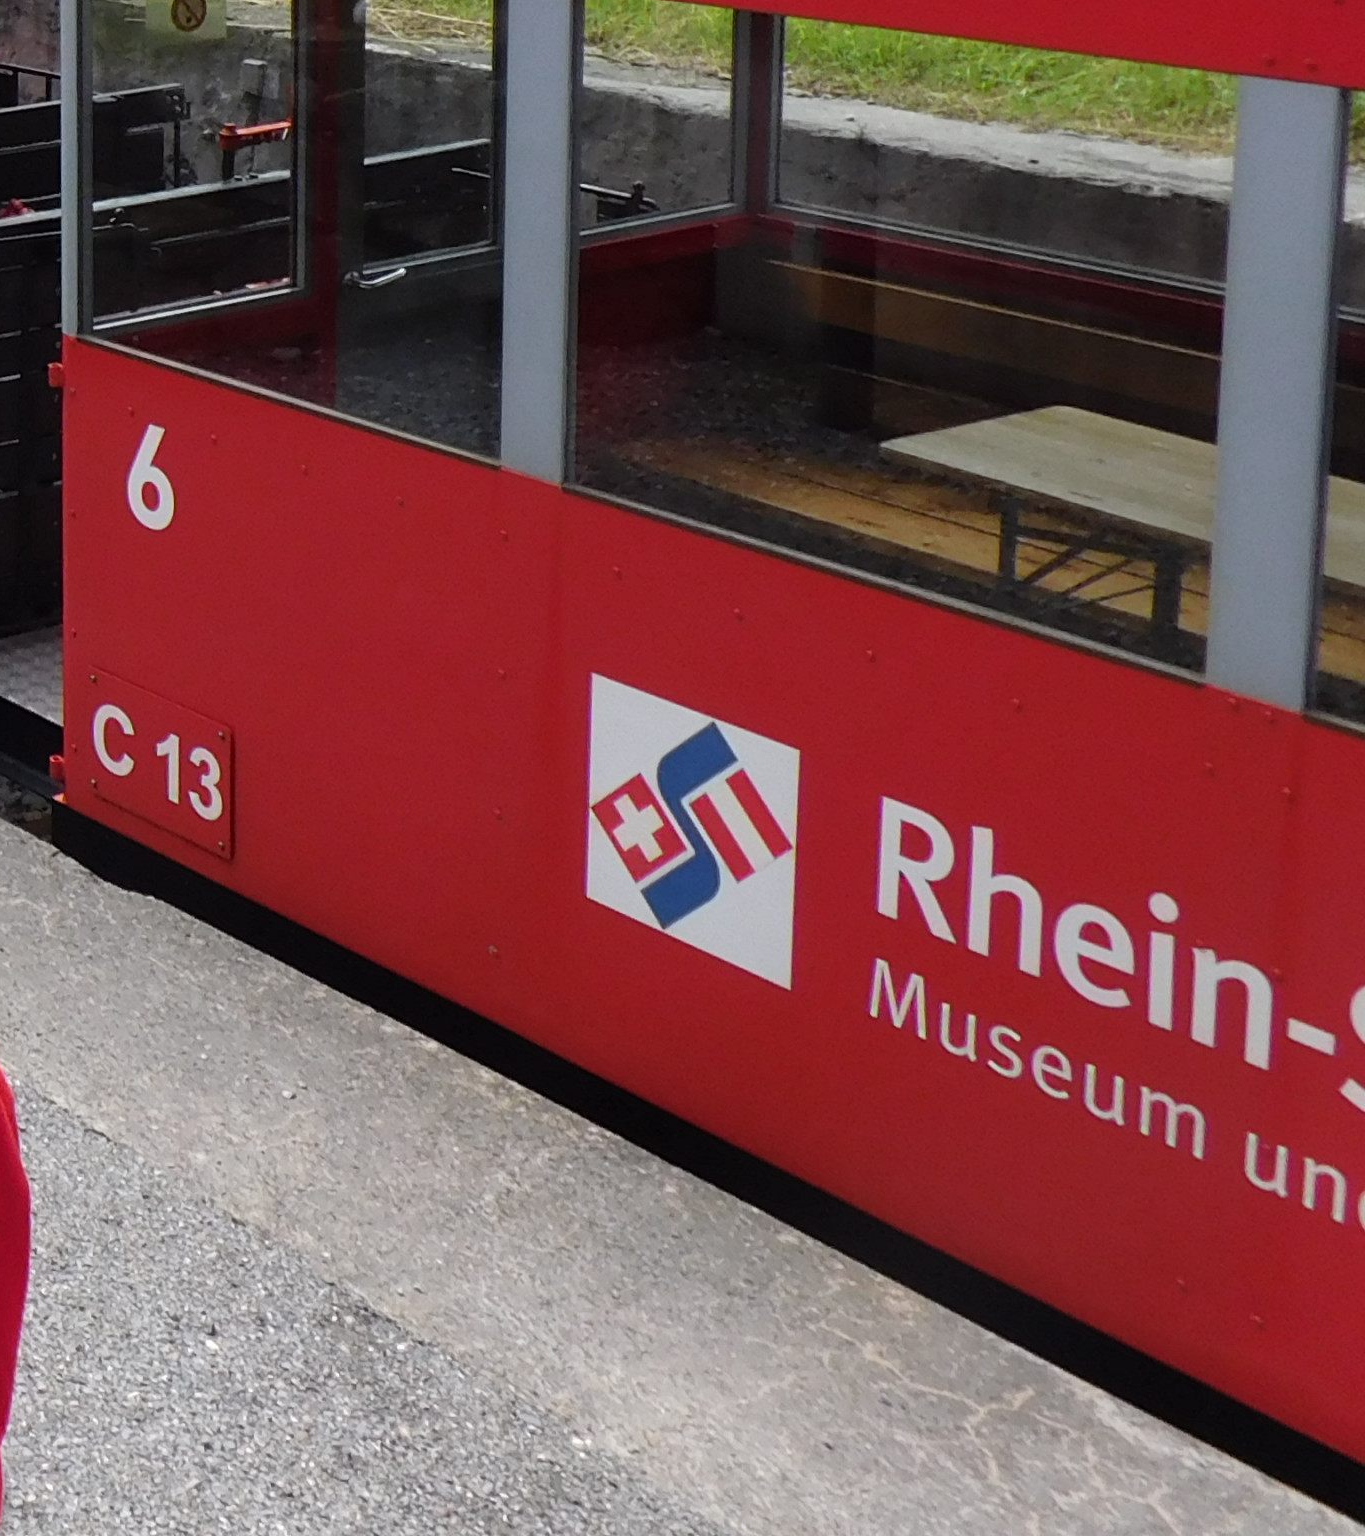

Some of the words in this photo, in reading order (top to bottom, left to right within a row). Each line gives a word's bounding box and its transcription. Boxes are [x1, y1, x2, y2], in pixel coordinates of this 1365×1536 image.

[126, 423, 175, 531] 6
[92, 703, 135, 777] C
[155, 732, 223, 821] 13
[876, 794, 1365, 1114] Rhein-
[868, 957, 1207, 1160] Museum
[1243, 1130, 1365, 1234] un
